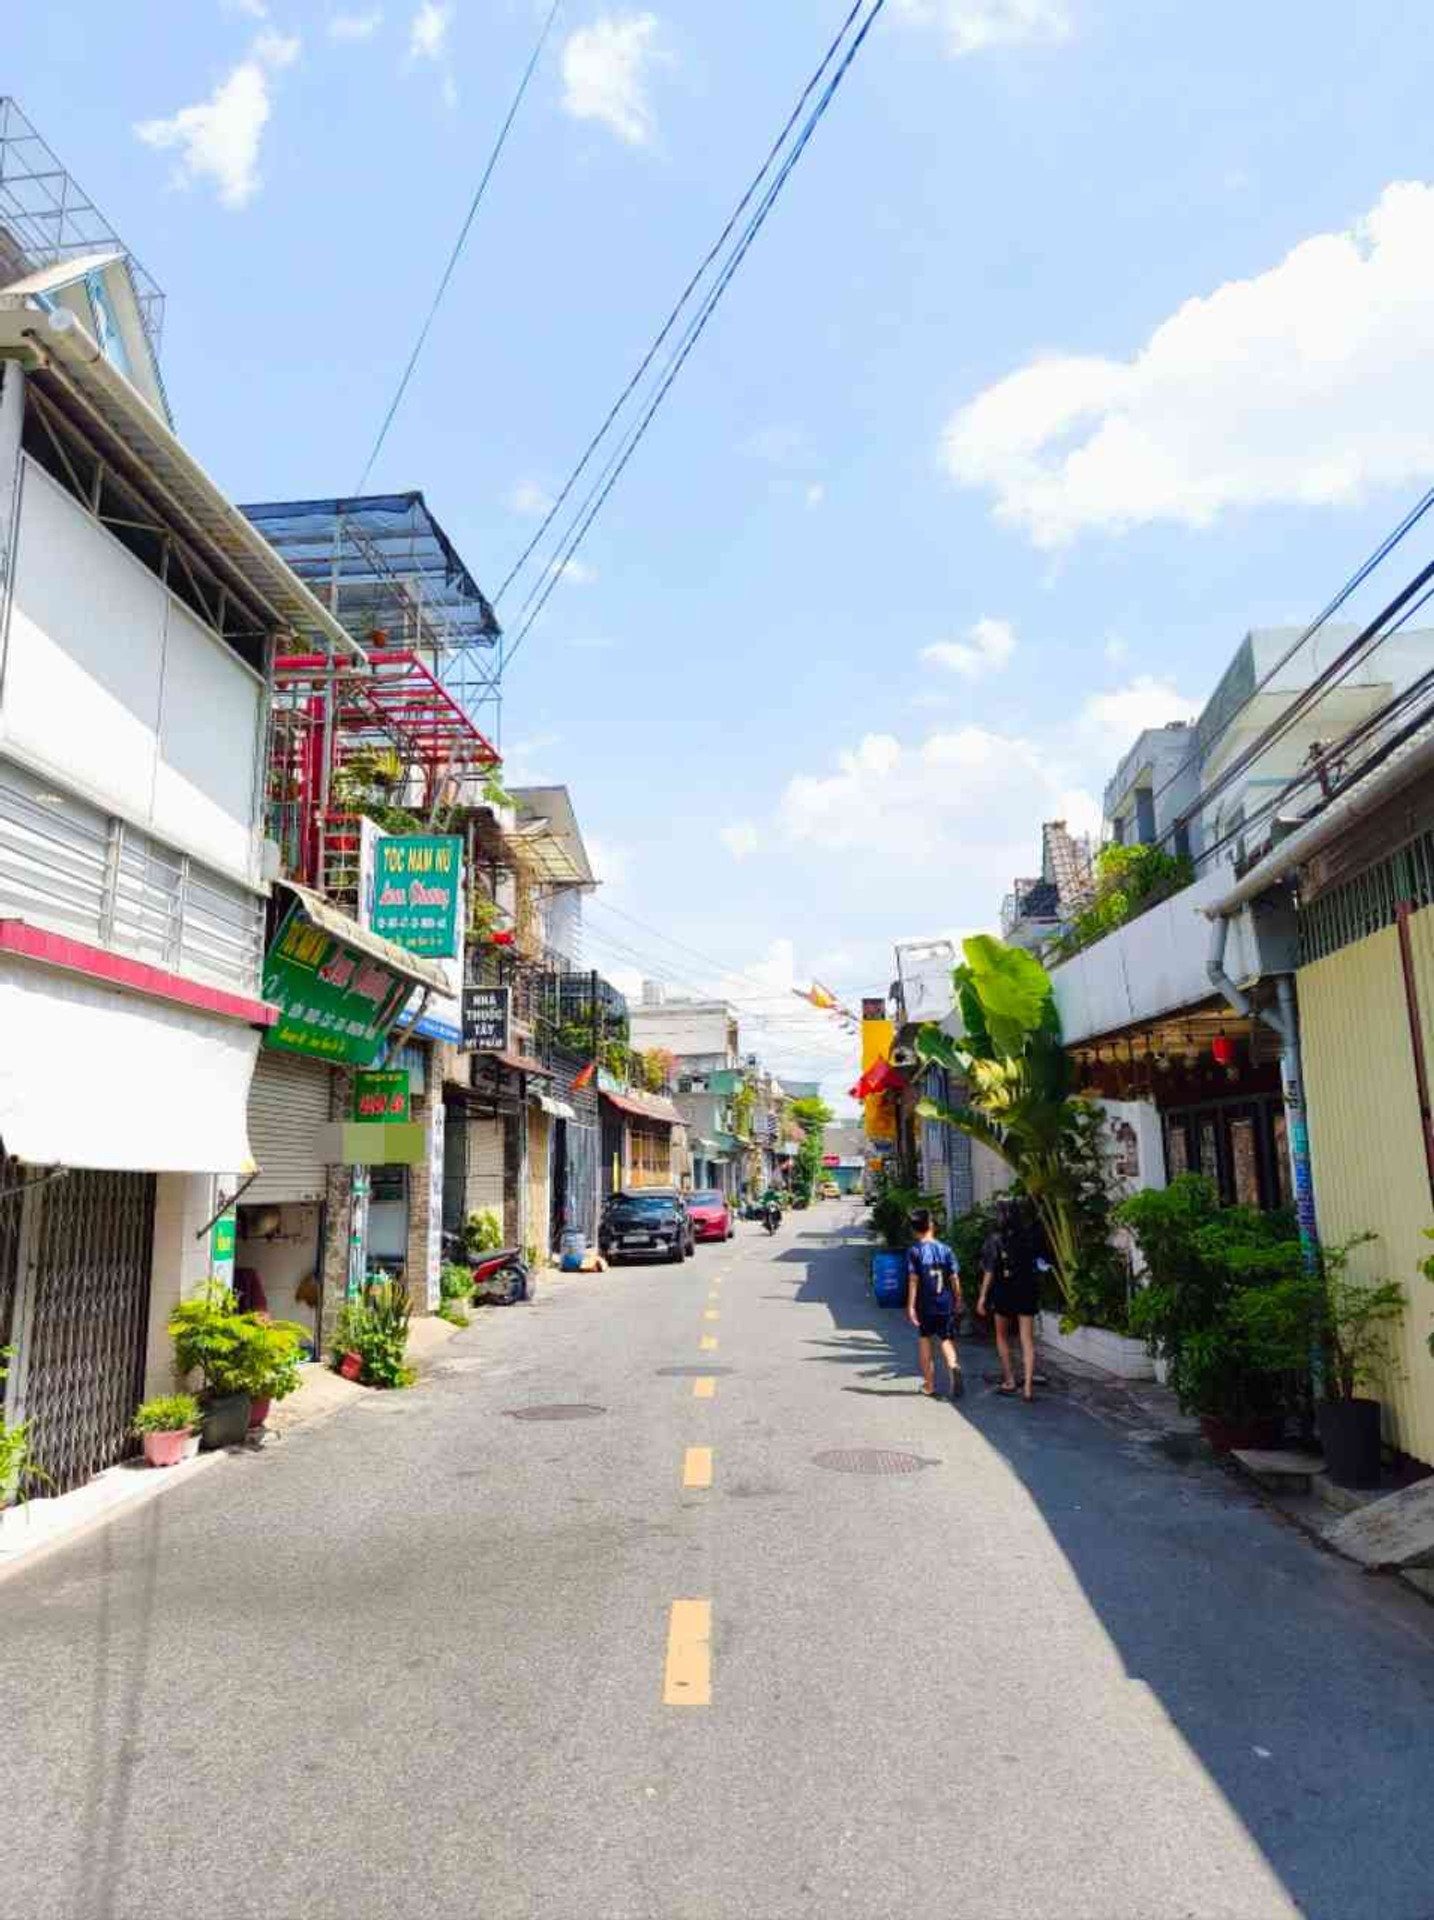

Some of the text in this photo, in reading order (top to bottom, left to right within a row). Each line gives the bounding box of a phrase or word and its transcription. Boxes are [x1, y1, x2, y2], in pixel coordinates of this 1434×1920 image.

[408, 846, 433, 872] NAM
[475, 1022, 495, 1035] TÂY
[929, 1268, 944, 1294] 7
